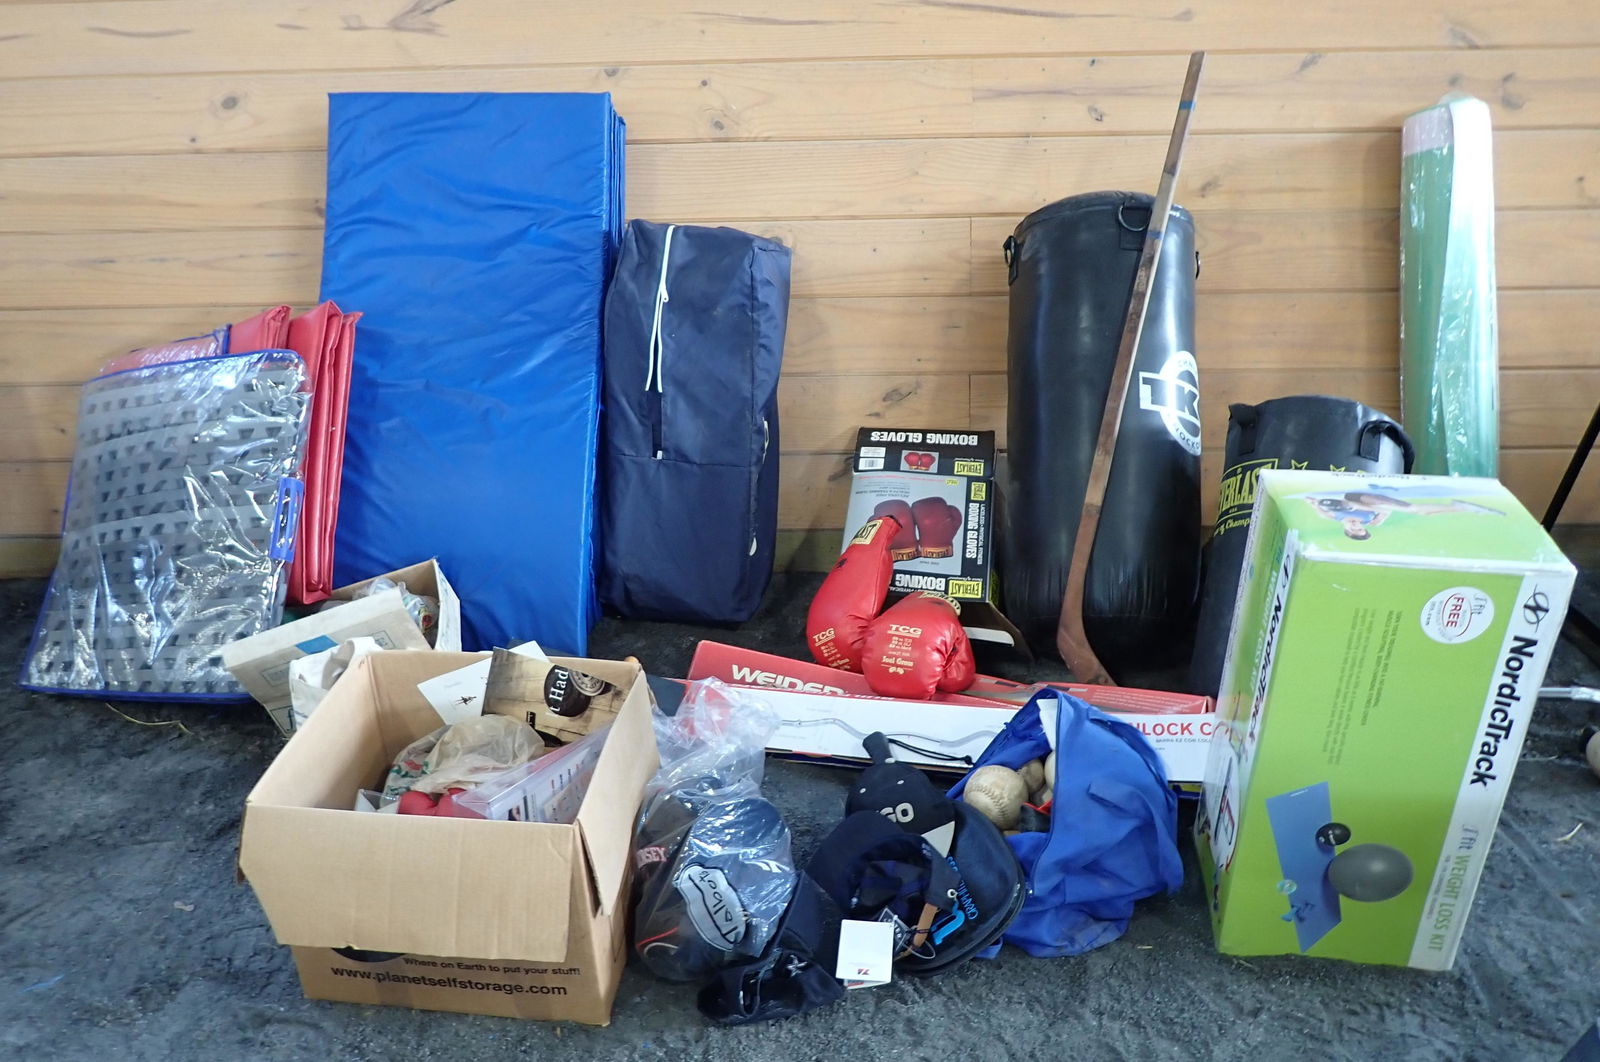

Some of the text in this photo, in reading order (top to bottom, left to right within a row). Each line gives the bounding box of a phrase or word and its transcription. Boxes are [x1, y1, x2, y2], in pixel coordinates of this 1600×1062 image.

[870, 430, 978, 446] BOXING GLOVES
[955, 462, 982, 475] EVERLAST
[966, 503, 979, 558] BOXING GLOVES
[895, 574, 945, 590] BOXING
[950, 582, 980, 596] EVERLAST
[1446, 596, 1465, 628] FREE
[549, 669, 569, 701] Had
[1469, 635, 1539, 787] NordicTrack
[1442, 854, 1470, 900] WEIGHT
[1433, 903, 1455, 931] LOSS
[1428, 933, 1444, 951] KIT
[402, 957, 438, 968] Where
[457, 962, 487, 971] Earth
[489, 964, 501, 972] to
[503, 966, 520, 974] put
[523, 967, 549, 976] your
[551, 968, 582, 976] stuff!
[330, 966, 568, 996] www.planetselfstorage.com
